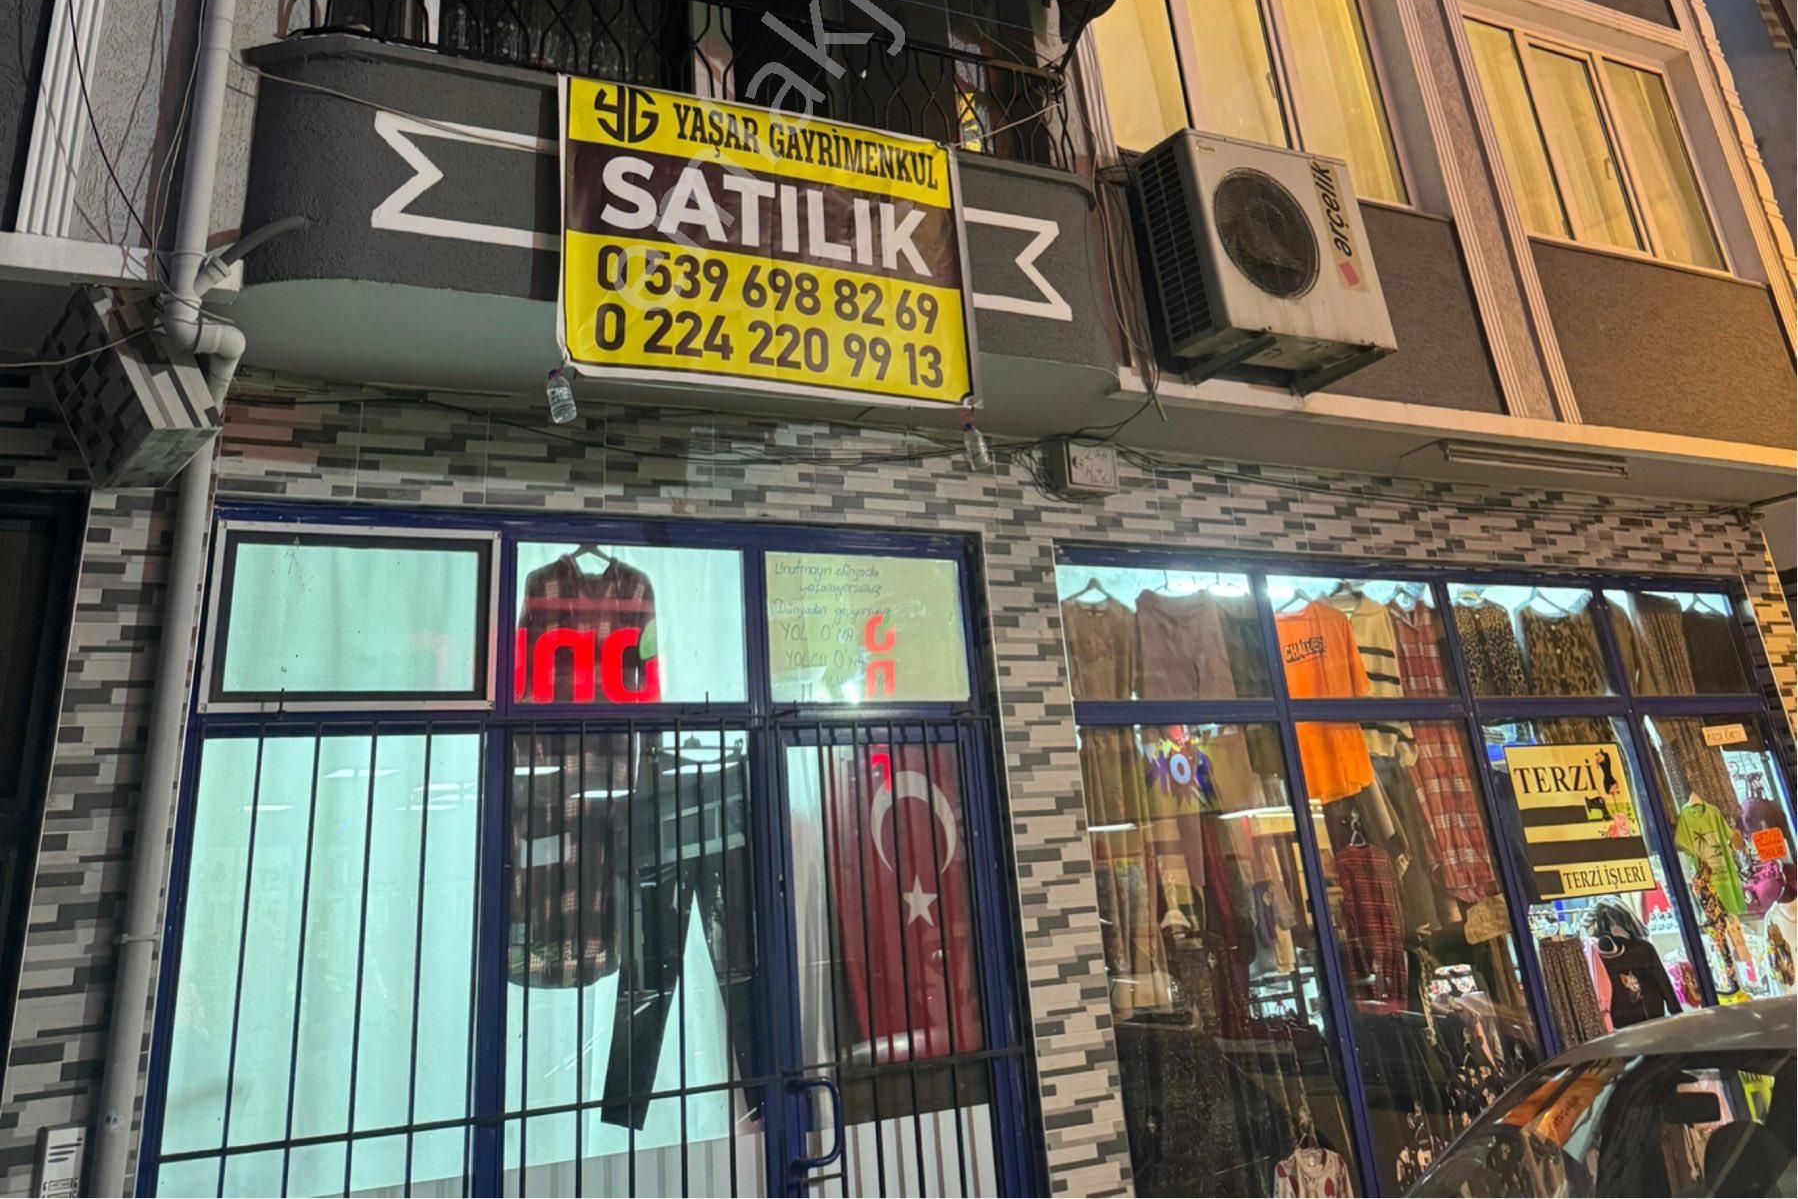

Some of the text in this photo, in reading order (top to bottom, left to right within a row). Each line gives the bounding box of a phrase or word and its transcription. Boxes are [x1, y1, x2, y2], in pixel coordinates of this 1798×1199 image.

[673, 103, 938, 190] YAŞAR GAYRİMENKUL
[601, 156, 932, 277] SATILIK
[1310, 159, 1352, 257] arçelik
[597, 244, 939, 335] 0 539 698 82 69
[595, 303, 943, 389] 0 224 220 99 13
[1514, 759, 1598, 795] TERZİ
[1563, 862, 1648, 890] TERZİ İŞLERİ
